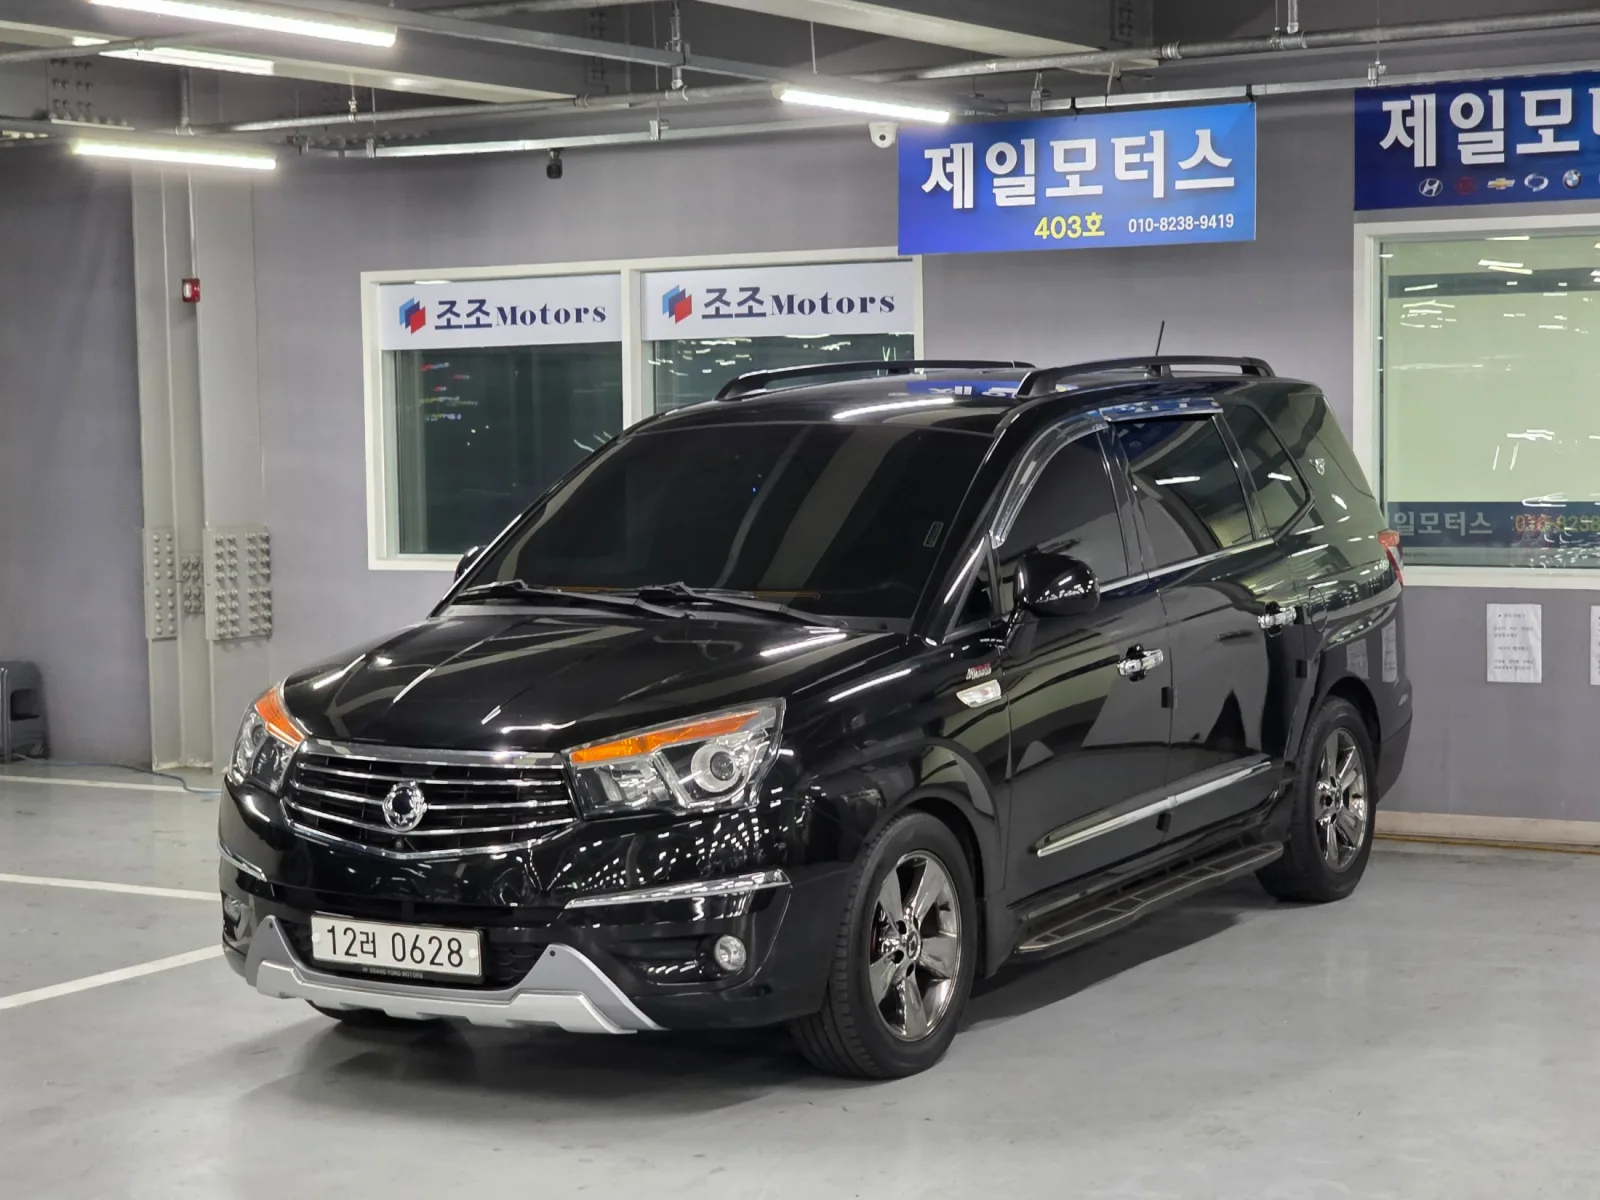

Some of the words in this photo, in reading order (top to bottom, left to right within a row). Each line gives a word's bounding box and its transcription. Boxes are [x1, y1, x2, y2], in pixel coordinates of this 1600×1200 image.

[921, 128, 1235, 209] 제일모터스
[1034, 211, 1105, 240] 403호
[1128, 213, 1235, 234] 010-8238-9419
[327, 925, 377, 958] 12러
[391, 931, 464, 968] 0628
